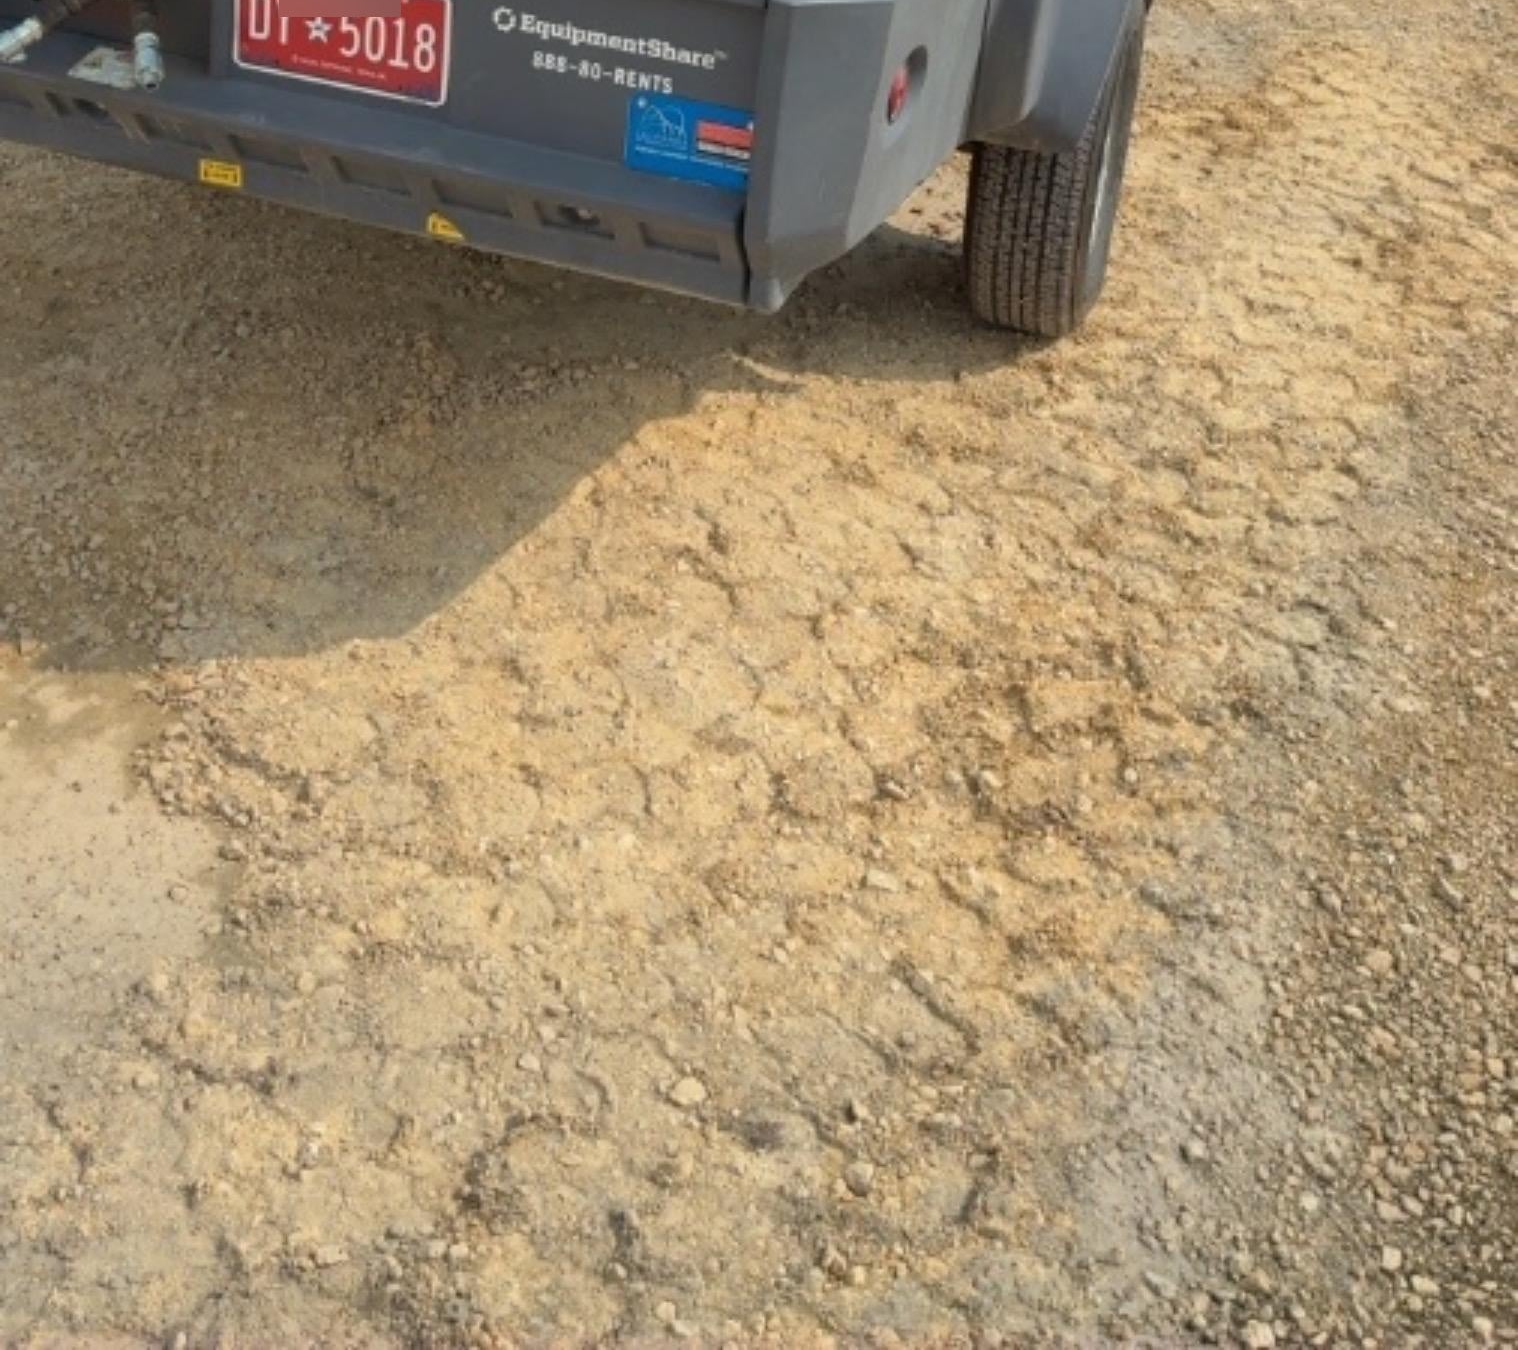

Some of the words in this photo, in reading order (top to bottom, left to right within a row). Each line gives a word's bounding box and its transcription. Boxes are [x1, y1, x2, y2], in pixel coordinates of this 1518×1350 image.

[339, 16, 437, 73] 5018
[520, 13, 716, 70] EquipmentShare
[532, 51, 674, 94] 888-80-RENTS
